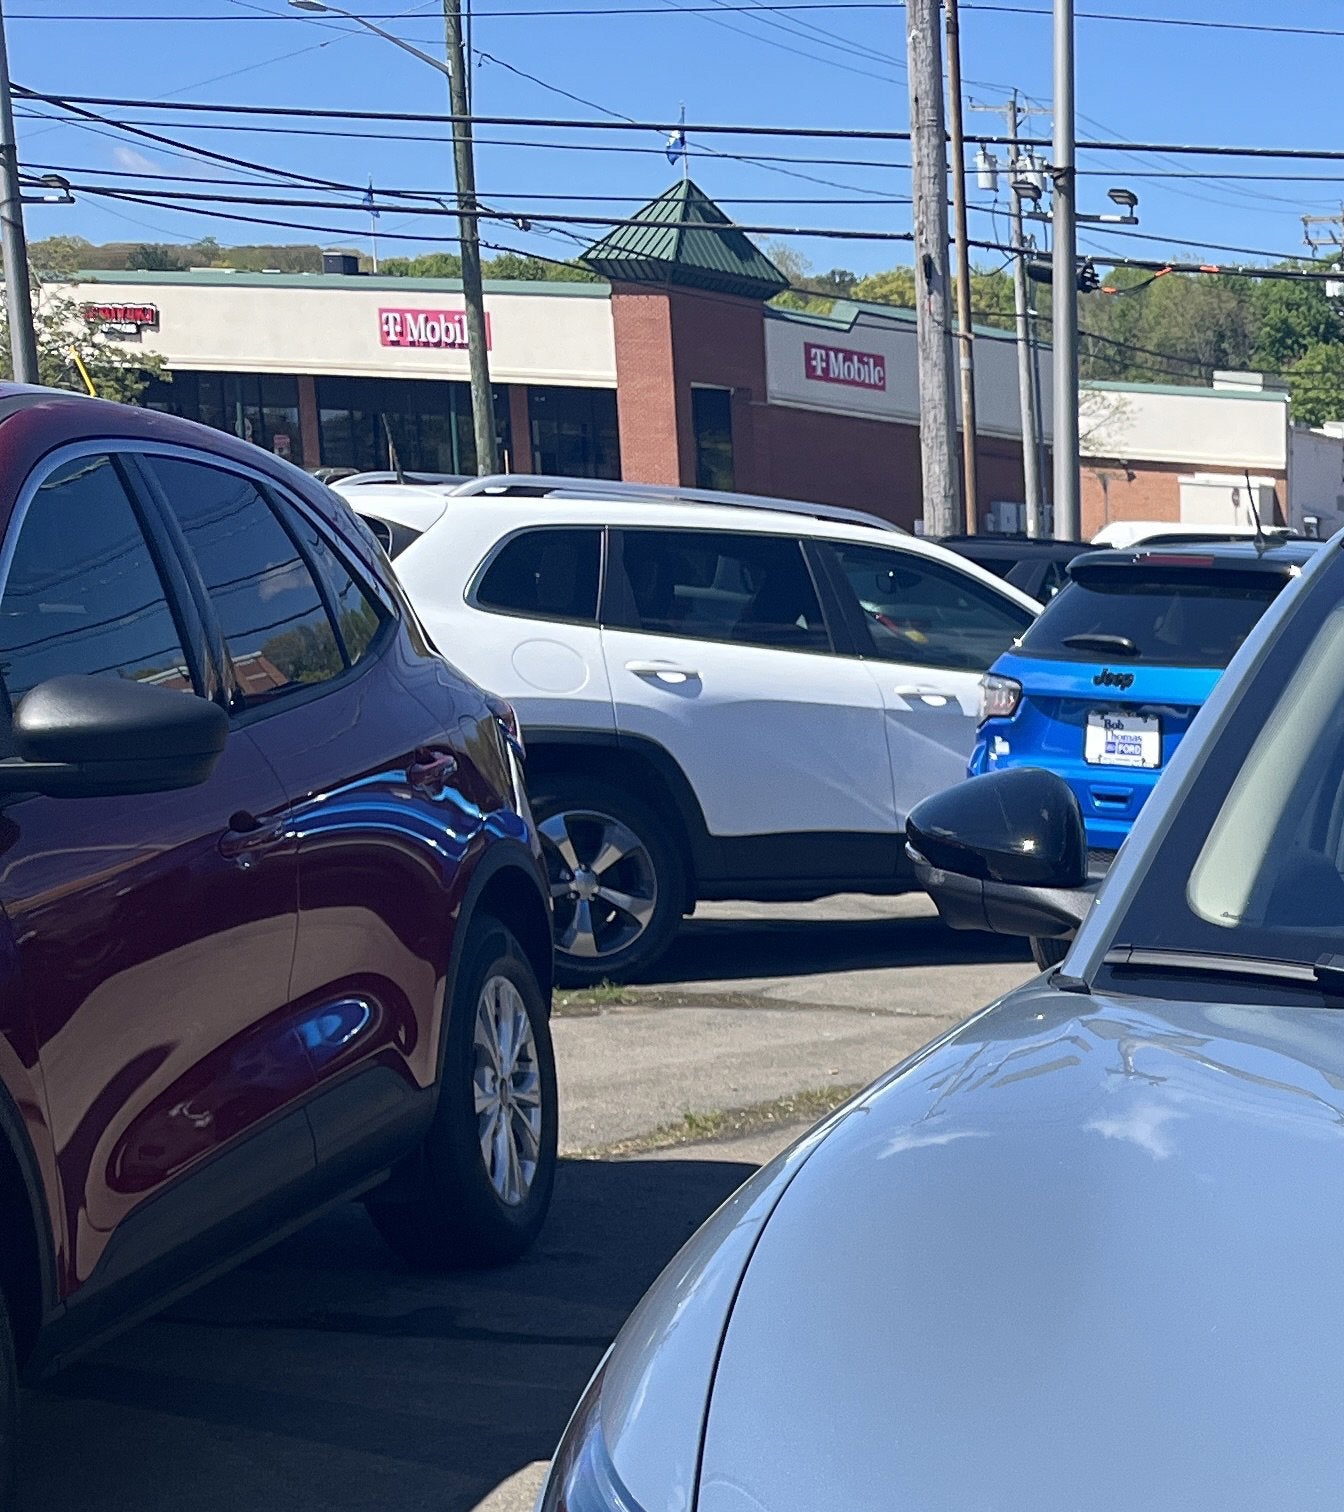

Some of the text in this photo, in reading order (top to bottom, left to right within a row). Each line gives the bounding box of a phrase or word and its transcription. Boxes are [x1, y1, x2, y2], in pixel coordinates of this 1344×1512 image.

[405, 313, 469, 343] Mobil
[829, 351, 883, 385] Mobile
[1104, 719, 1124, 731] Bob
[1119, 742, 1142, 755] FORD
